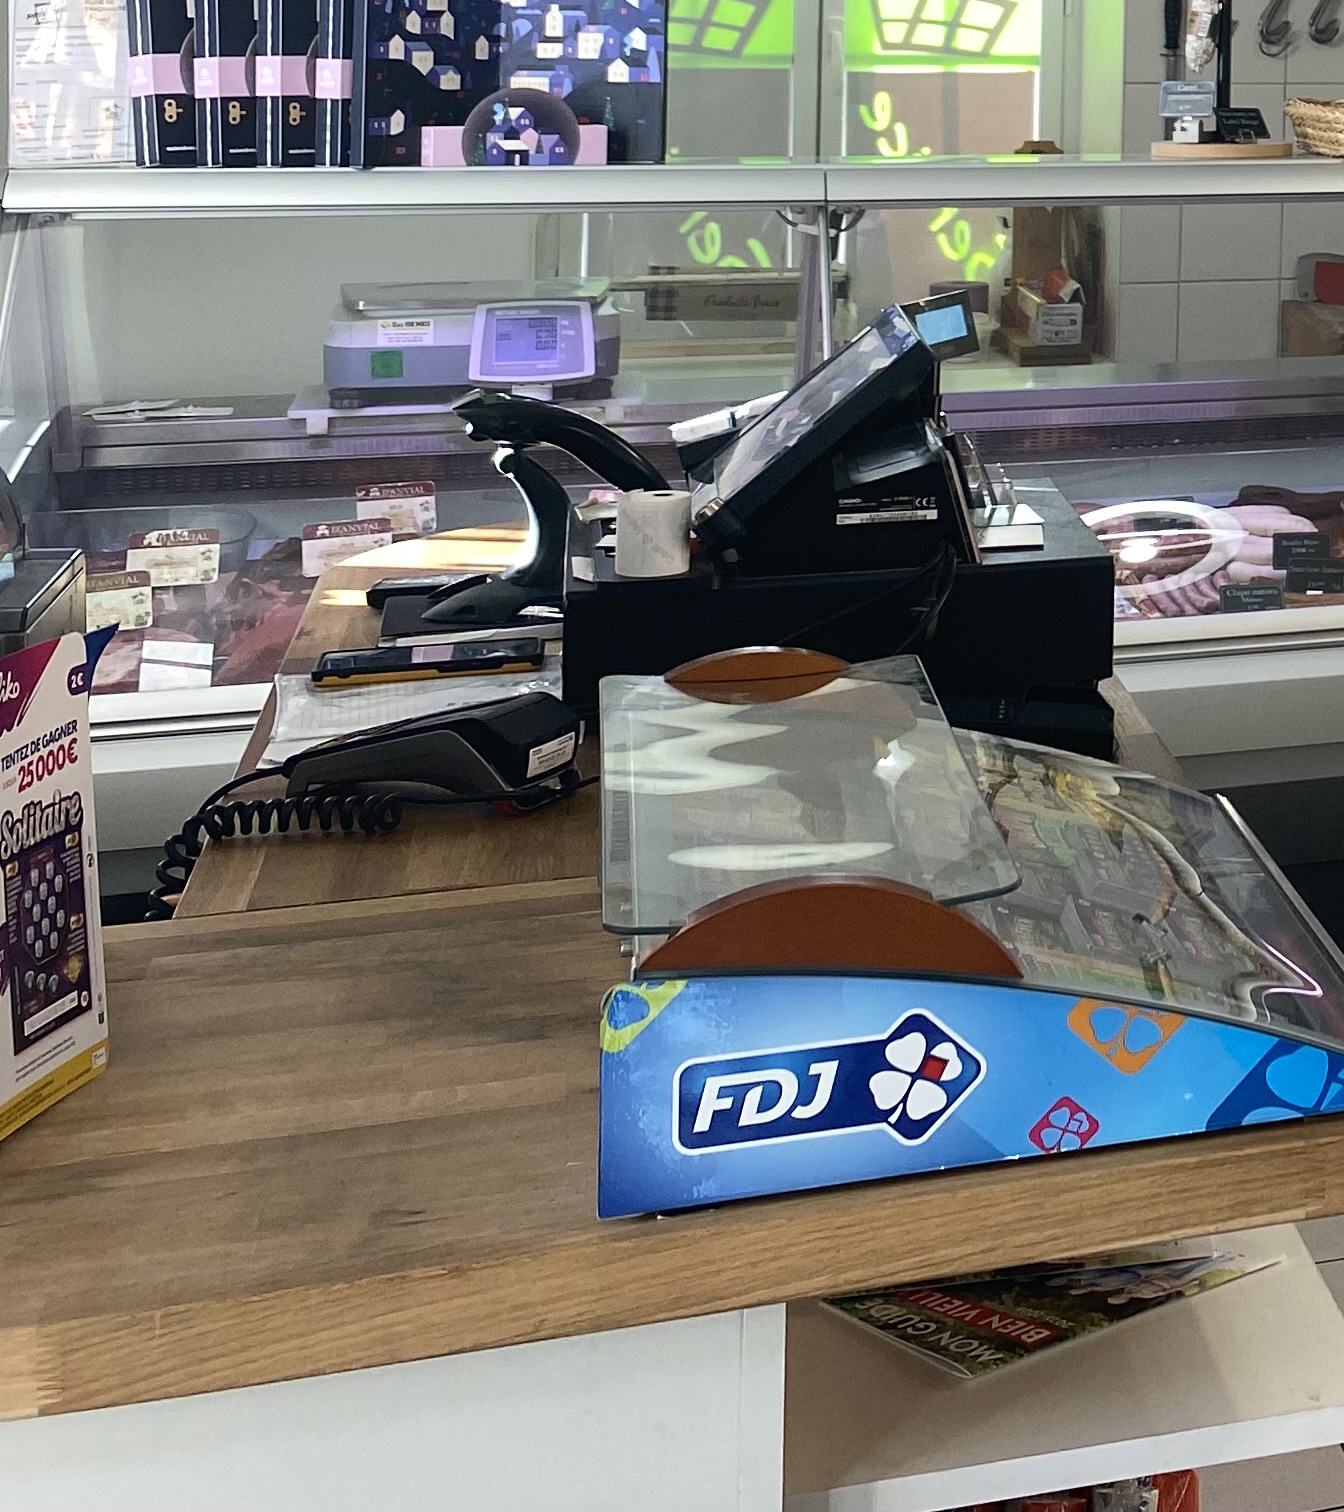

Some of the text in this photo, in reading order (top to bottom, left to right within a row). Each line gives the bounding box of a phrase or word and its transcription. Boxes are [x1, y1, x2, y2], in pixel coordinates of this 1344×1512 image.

[1, 719, 78, 773] TENTEZ DE GAGNER
[0, 789, 83, 861] Solitaire
[693, 1060, 840, 1134] FDJ
[930, 1331, 1005, 1363] MON
[978, 1313, 1051, 1343] BIEN
